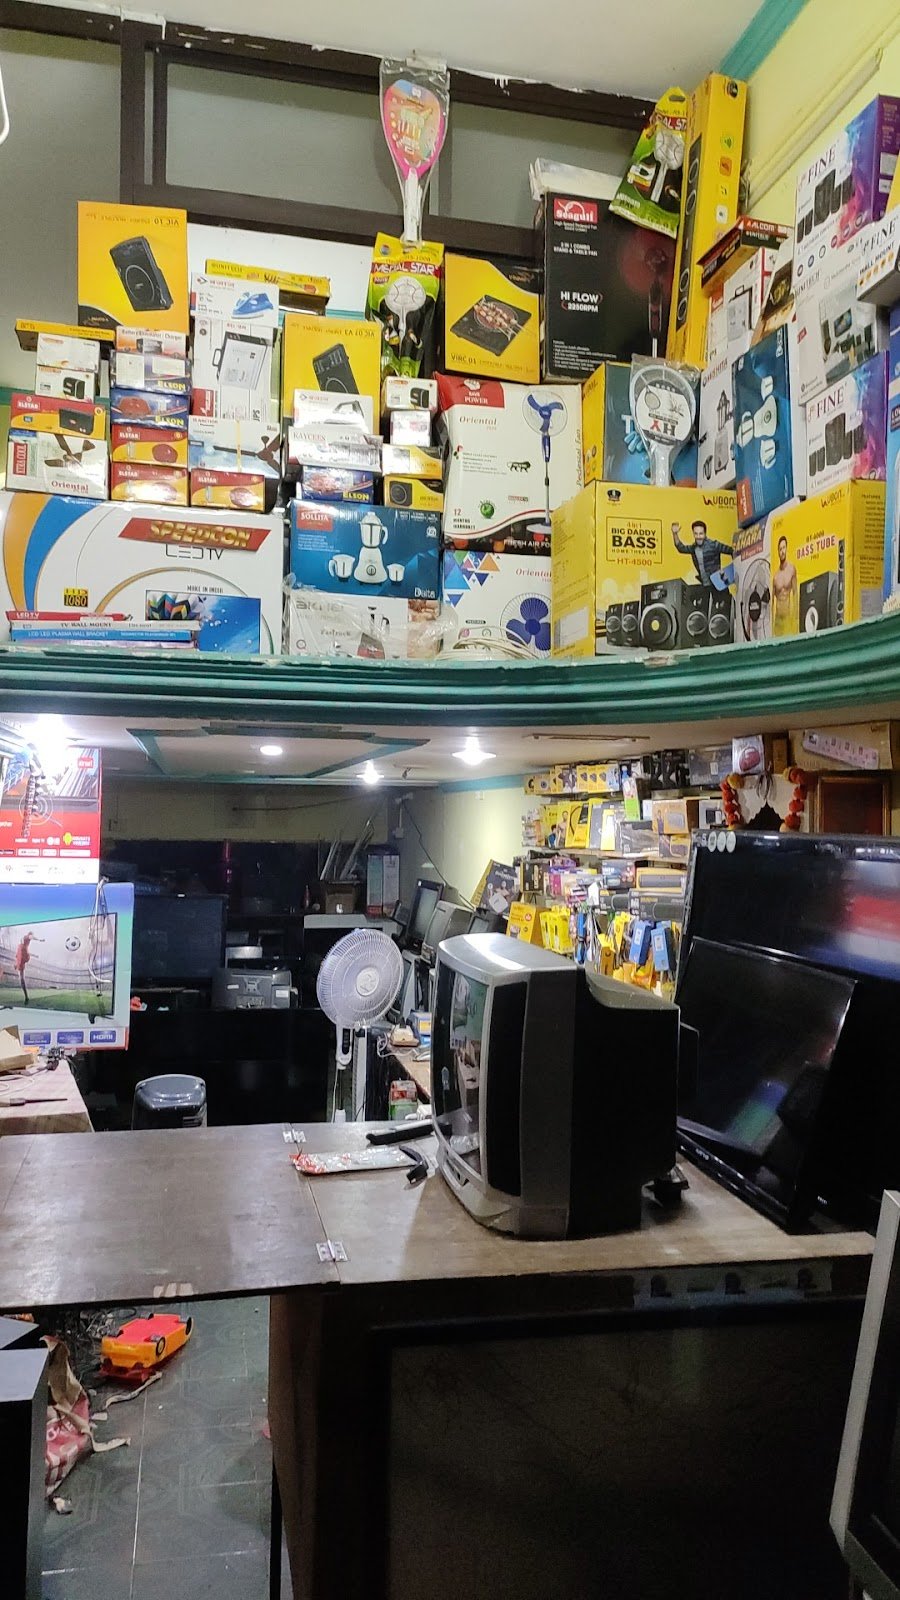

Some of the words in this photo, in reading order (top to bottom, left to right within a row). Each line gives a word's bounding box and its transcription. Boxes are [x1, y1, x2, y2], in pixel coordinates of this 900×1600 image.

[808, 146, 836, 183] FINE
[556, 209, 594, 222] Seagull
[410, 262, 435, 275] STAR
[560, 291, 570, 300] HI
[572, 292, 599, 303] FLOW
[464, 396, 488, 404] POWER
[816, 386, 844, 418] FINE
[459, 415, 497, 426] Oriental
[51, 480, 89, 490] Oriental
[342, 490, 370, 501] ELSON
[150, 520, 251, 548] SPEEDCON
[611, 527, 626, 535] BIG
[627, 528, 657, 537] DADDY
[612, 535, 657, 549] BASS
[796, 544, 814, 560] BASS
[816, 535, 836, 550] TUBE
[617, 558, 652, 566] HT-4500
[65, 595, 88, 607] 1080
[93, 1033, 114, 1041] HDMI
